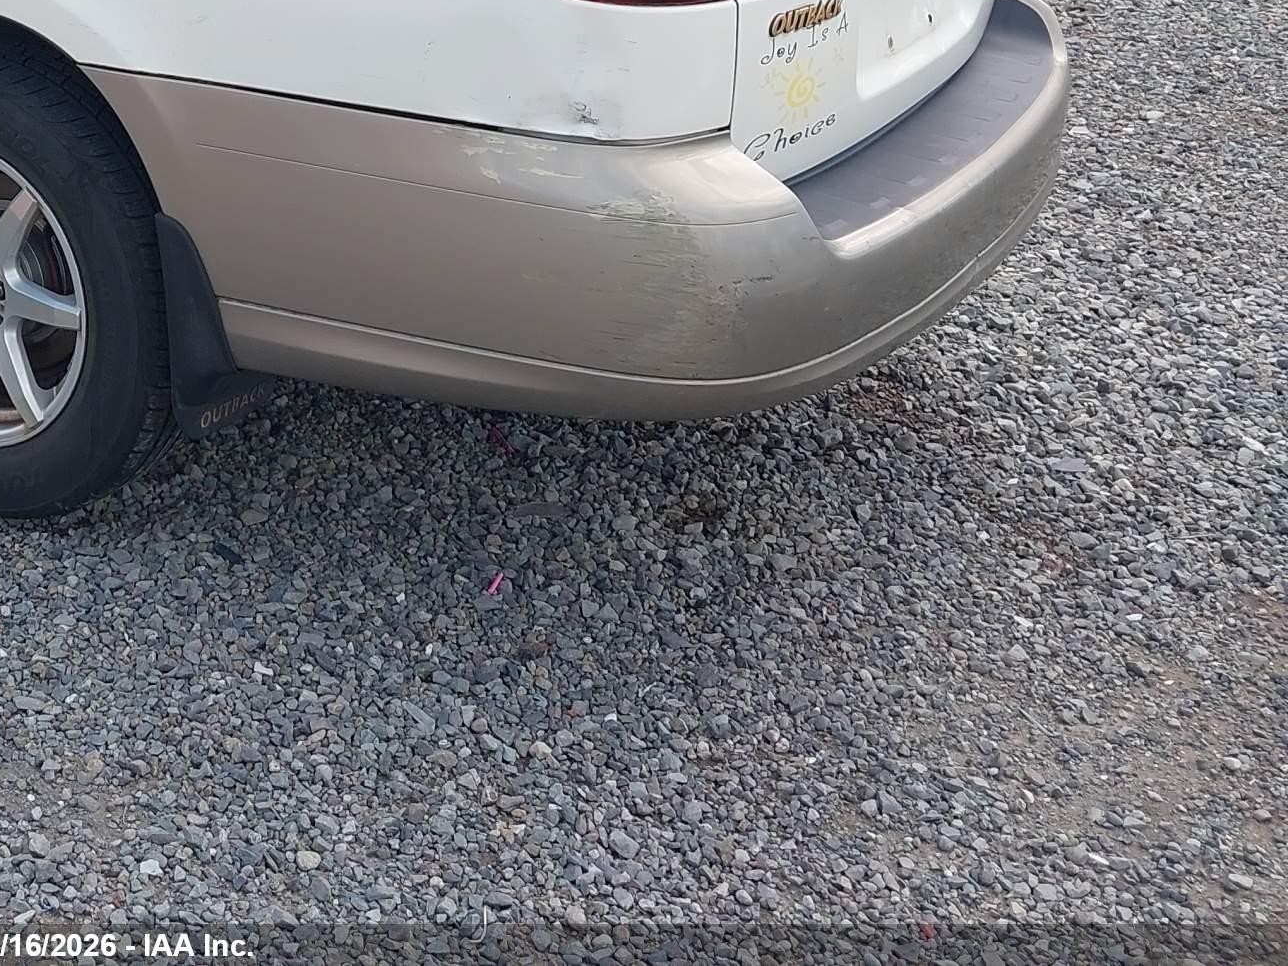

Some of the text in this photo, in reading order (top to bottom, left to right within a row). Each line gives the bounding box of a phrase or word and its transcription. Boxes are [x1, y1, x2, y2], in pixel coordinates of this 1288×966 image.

[760, 36, 798, 65] Joy
[836, 11, 849, 37] A
[744, 113, 836, 161] Choice
